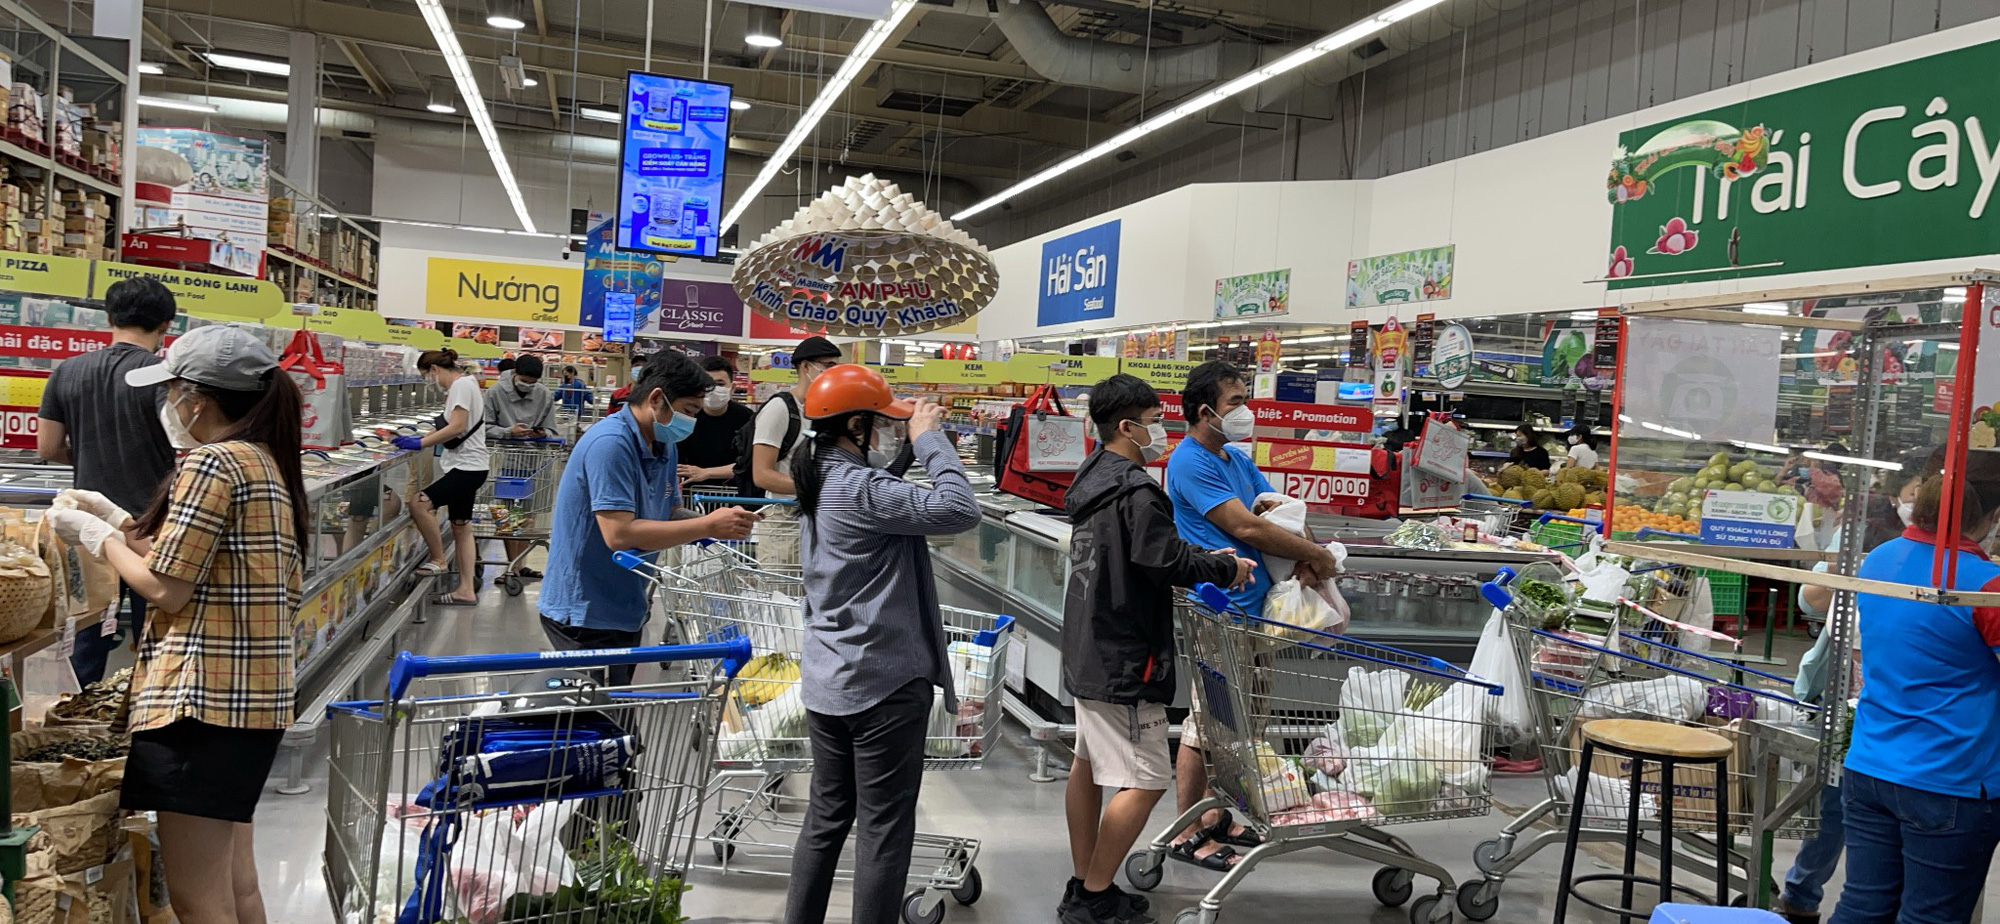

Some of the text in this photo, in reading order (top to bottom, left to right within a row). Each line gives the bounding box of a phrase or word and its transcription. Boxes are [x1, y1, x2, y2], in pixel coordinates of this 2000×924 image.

[6, 258, 49, 273] PIZZA
[1047, 245, 1107, 297] Hải Sản
[225, 282, 259, 294] LẠNH
[458, 271, 559, 312] Nướng
[752, 281, 958, 329] Kính Chào Quý Khách
[531, 313, 559, 322] Grilled
[660, 307, 724, 322] CLASSIC
[27, 332, 63, 353] đặc
[964, 363, 983, 371] KEM
[1257, 409, 1282, 421] biệt
[1292, 411, 1357, 425] Promotion
[1726, 525, 1752, 534] KHÁCH
